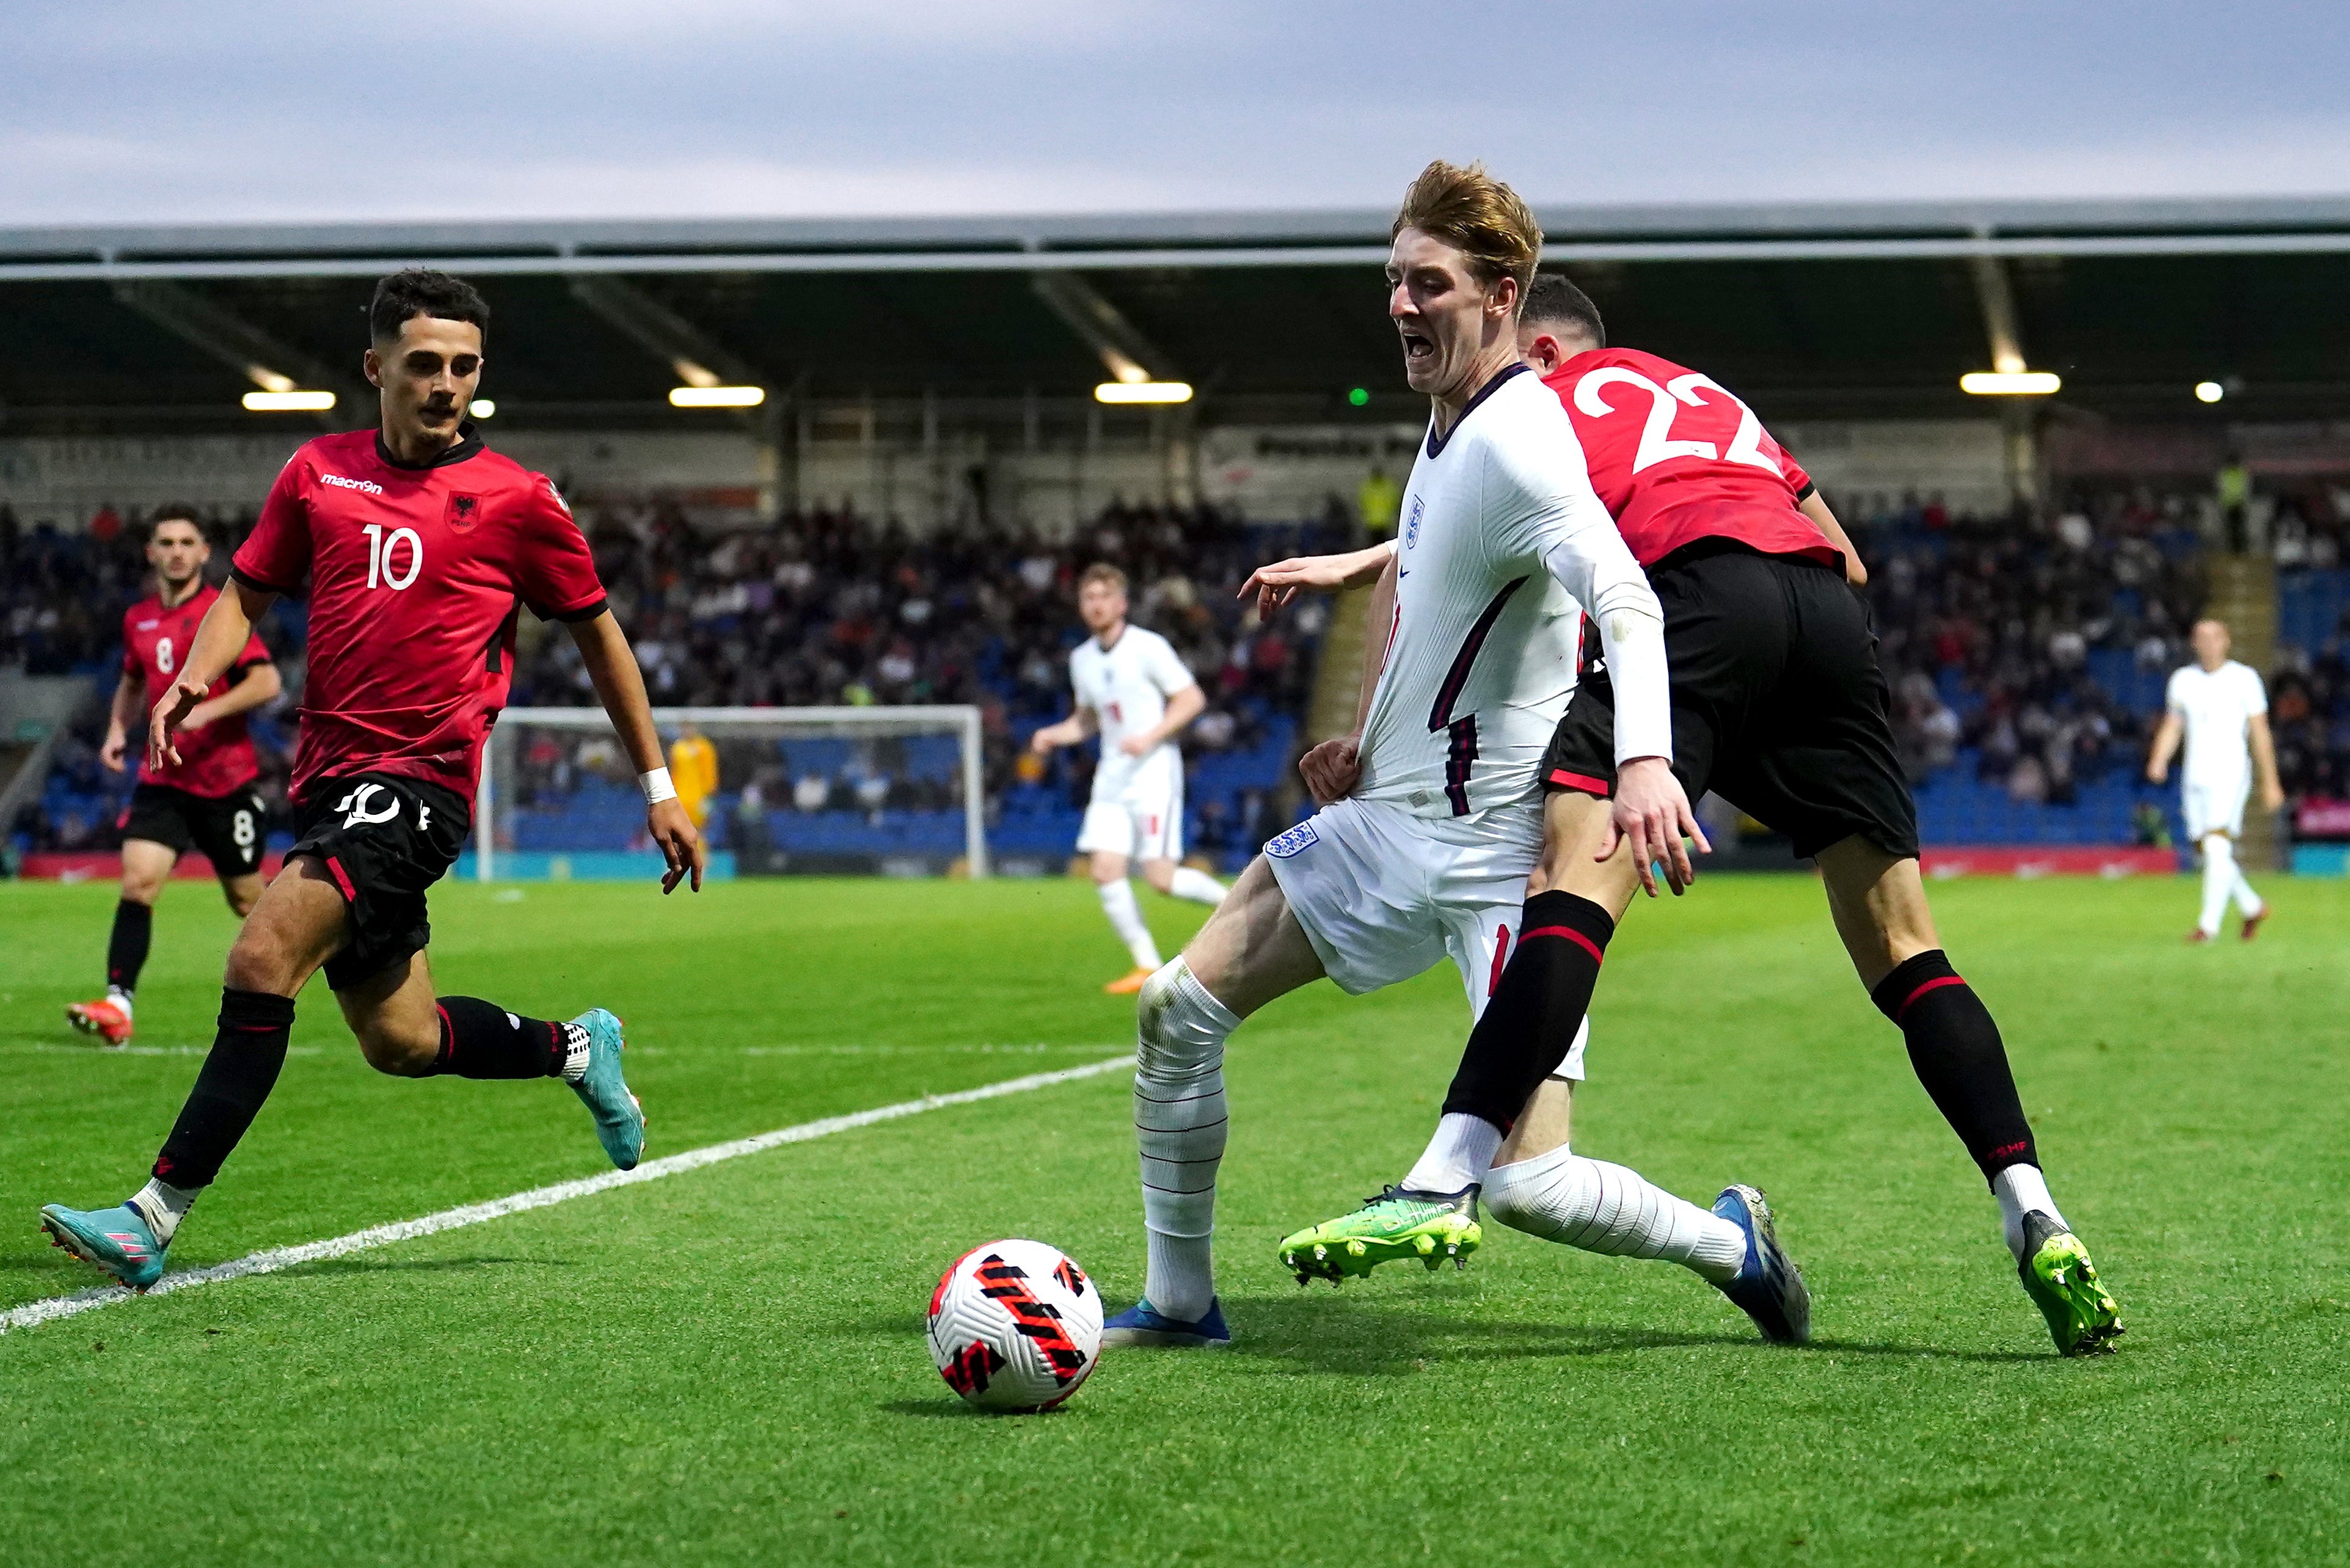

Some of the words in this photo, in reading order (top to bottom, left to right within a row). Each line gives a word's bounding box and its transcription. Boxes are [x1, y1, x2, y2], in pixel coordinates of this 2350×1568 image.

[1574, 366, 1785, 475] 22
[362, 523, 423, 591] 10
[156, 637, 174, 674] 8
[234, 809, 255, 846] 8
